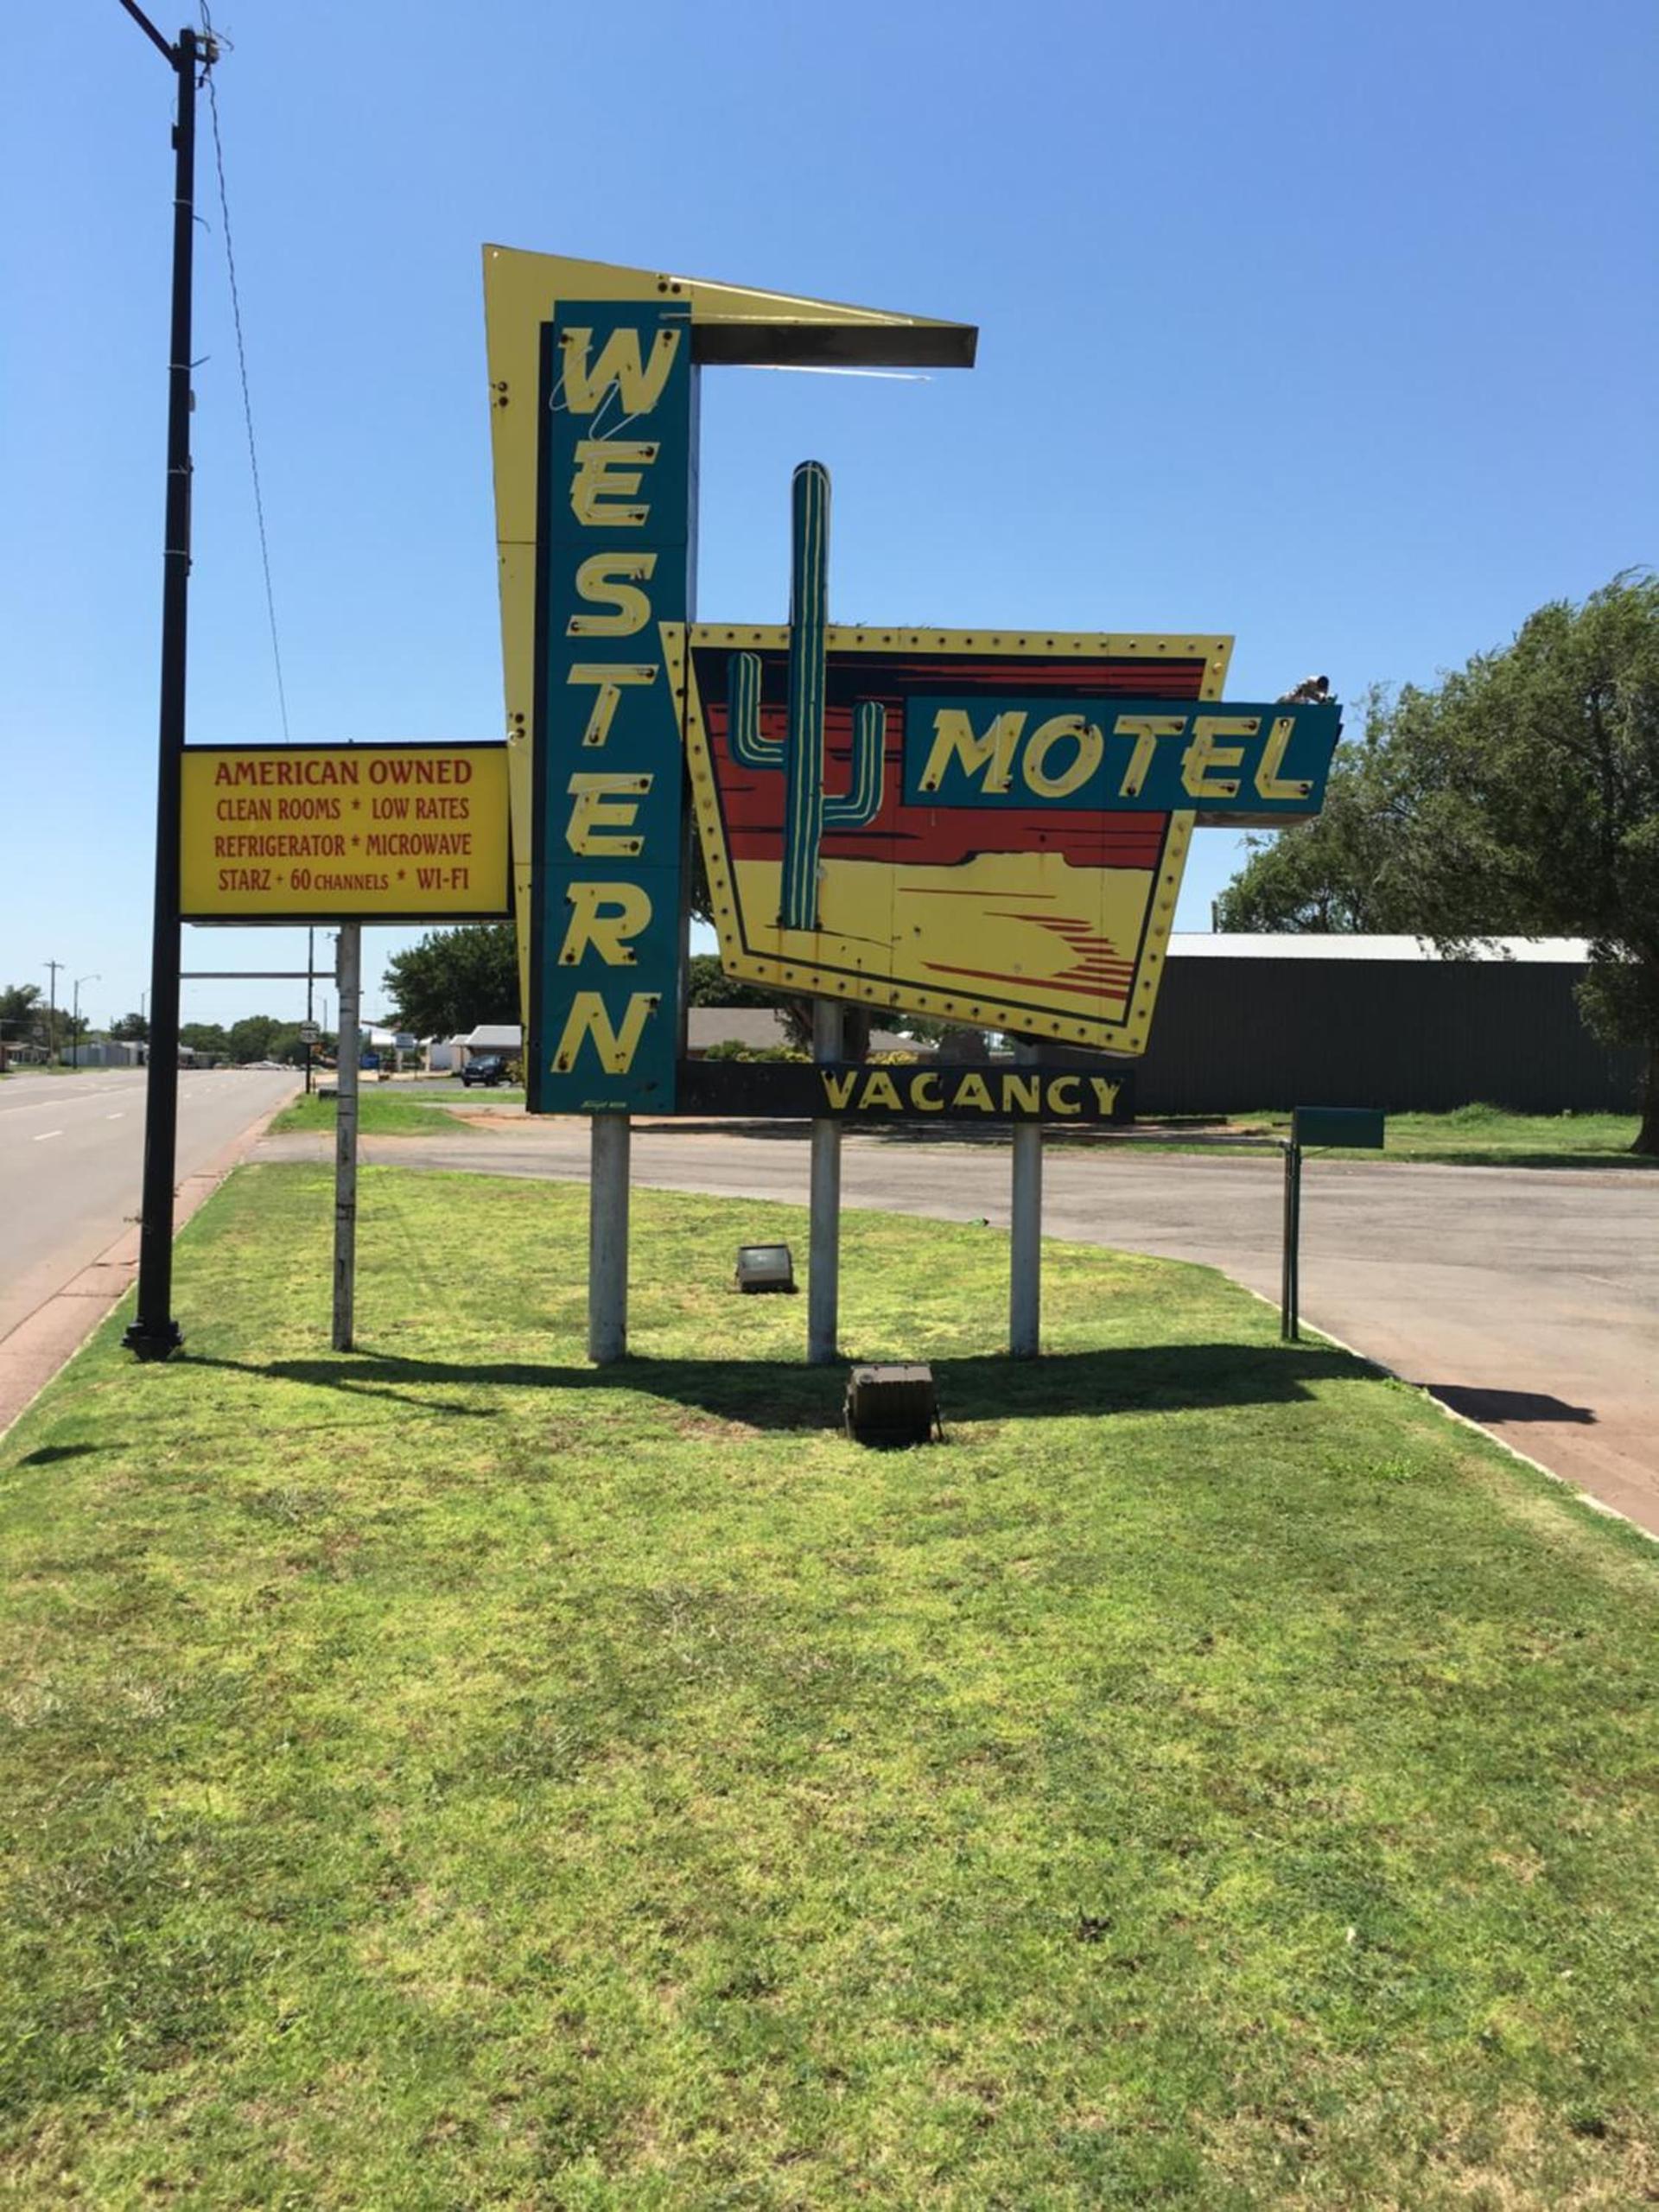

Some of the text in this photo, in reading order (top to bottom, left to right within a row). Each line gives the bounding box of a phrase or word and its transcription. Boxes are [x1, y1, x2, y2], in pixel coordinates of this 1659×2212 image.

[550, 327, 681, 1073] WESTERN
[918, 709, 1314, 798] MOTEL
[215, 760, 473, 785] AMERICAN OWNED
[217, 797, 470, 821] CLEAN ROOMS LOW RATES
[214, 834, 472, 857] REFRIGERATOR MICROWAVE
[219, 868, 469, 891] STARZ 60 CHANNELS WI-FI
[821, 1071, 1124, 1116] VACANCY
